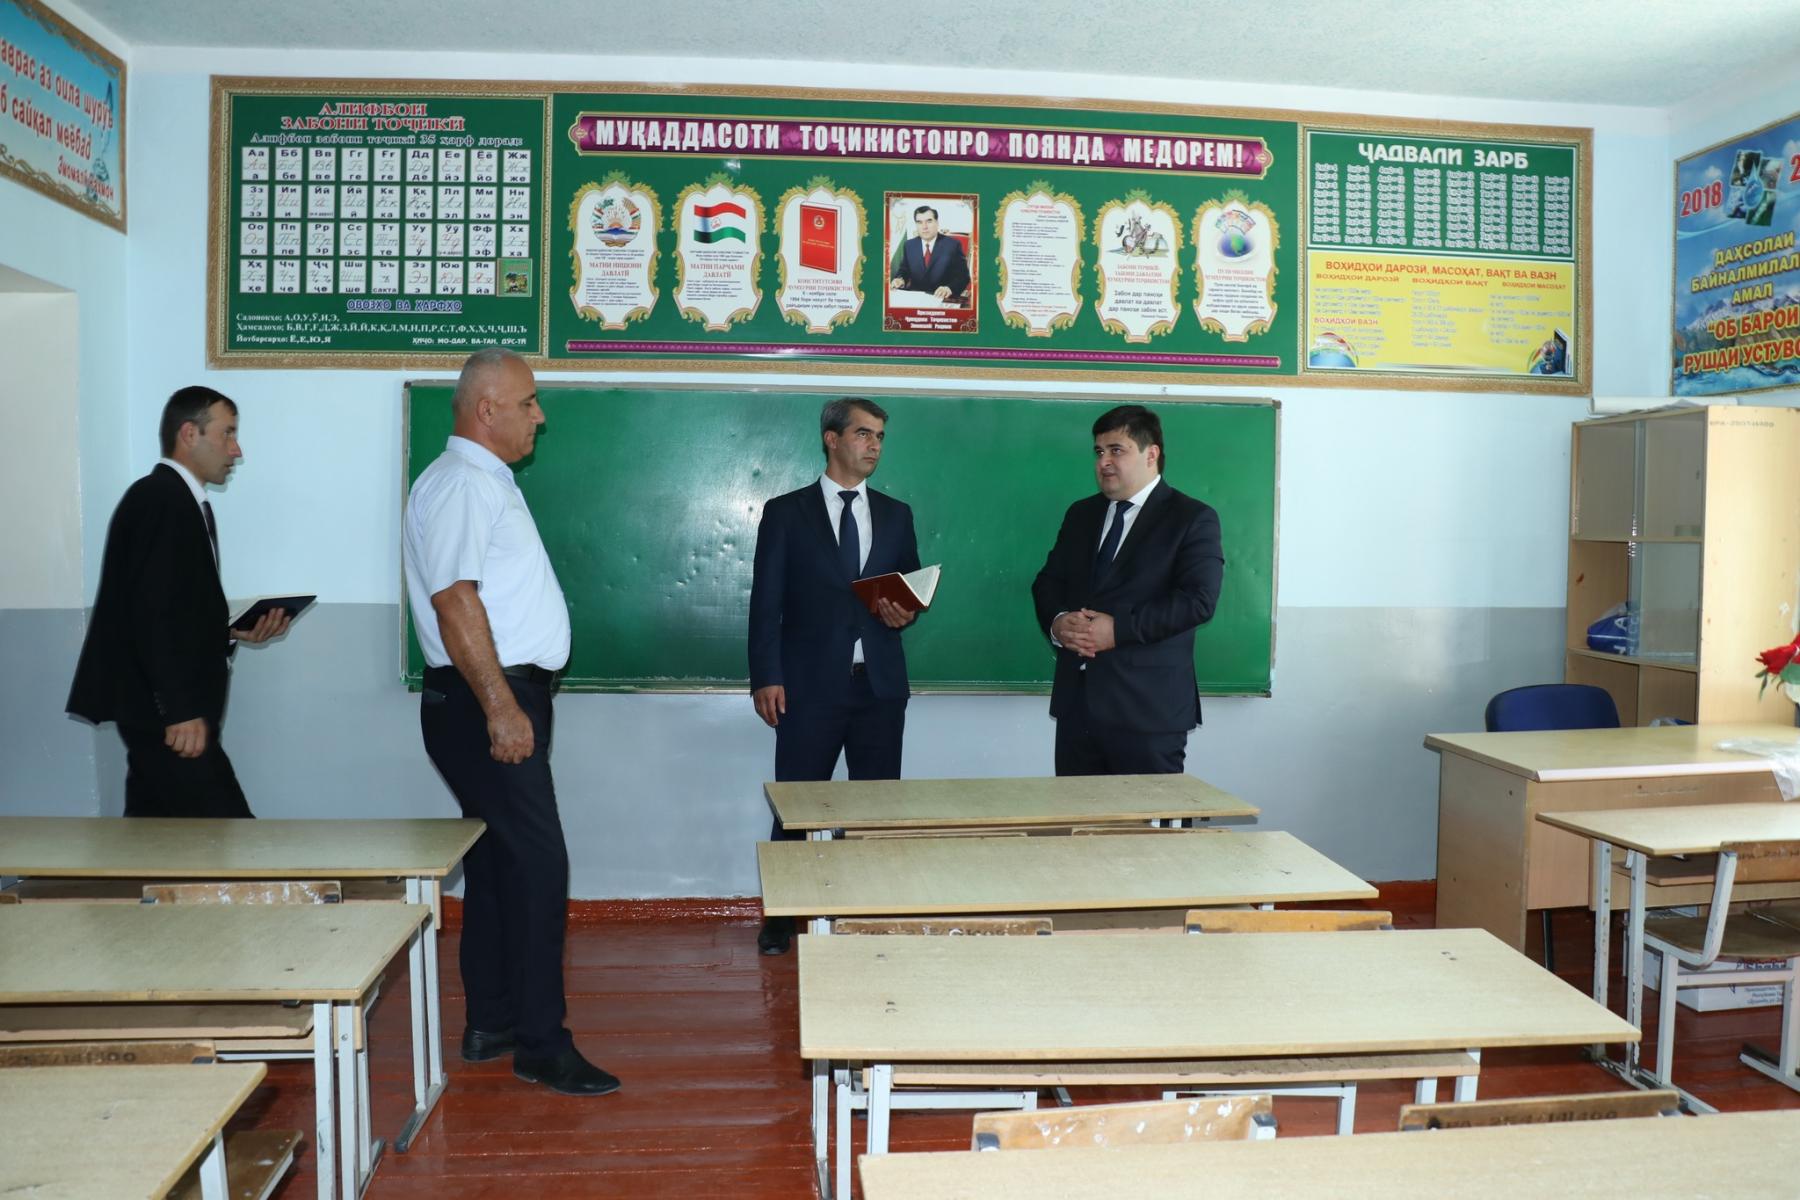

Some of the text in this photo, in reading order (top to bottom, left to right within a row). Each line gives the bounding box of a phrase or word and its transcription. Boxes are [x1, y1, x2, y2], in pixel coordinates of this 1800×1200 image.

[0, 38, 36, 80] аврас
[40, 63, 51, 90] аз
[55, 75, 80, 108] оила
[318, 102, 428, 116] АЛИФБОИ
[12, 96, 52, 139] сайқал
[57, 121, 92, 161] меёбад
[281, 116, 368, 130] ЗАБОНИ
[420, 135, 436, 144] 35
[596, 120, 1244, 168] МУҚАДДАСОТИ ТОҶИКИСТОНРО ПОЯНДА МЕДОРЕМ!
[1358, 142, 1529, 169] ҶАДВАЛИ ЗАРБ
[1681, 180, 1723, 218] 2018
[1715, 232, 1794, 267] ДАҲСОЛАИ
[1325, 261, 1383, 272] ВОҲИДҲОИ
[1486, 268, 1511, 279] ВАҚТ
[1514, 270, 1528, 279] ВА
[1530, 271, 1557, 280] ВАЗН
[395, 300, 411, 311] ВА
[1732, 282, 1773, 304] АМАЛ
[1740, 304, 1800, 336] БАРОИ
